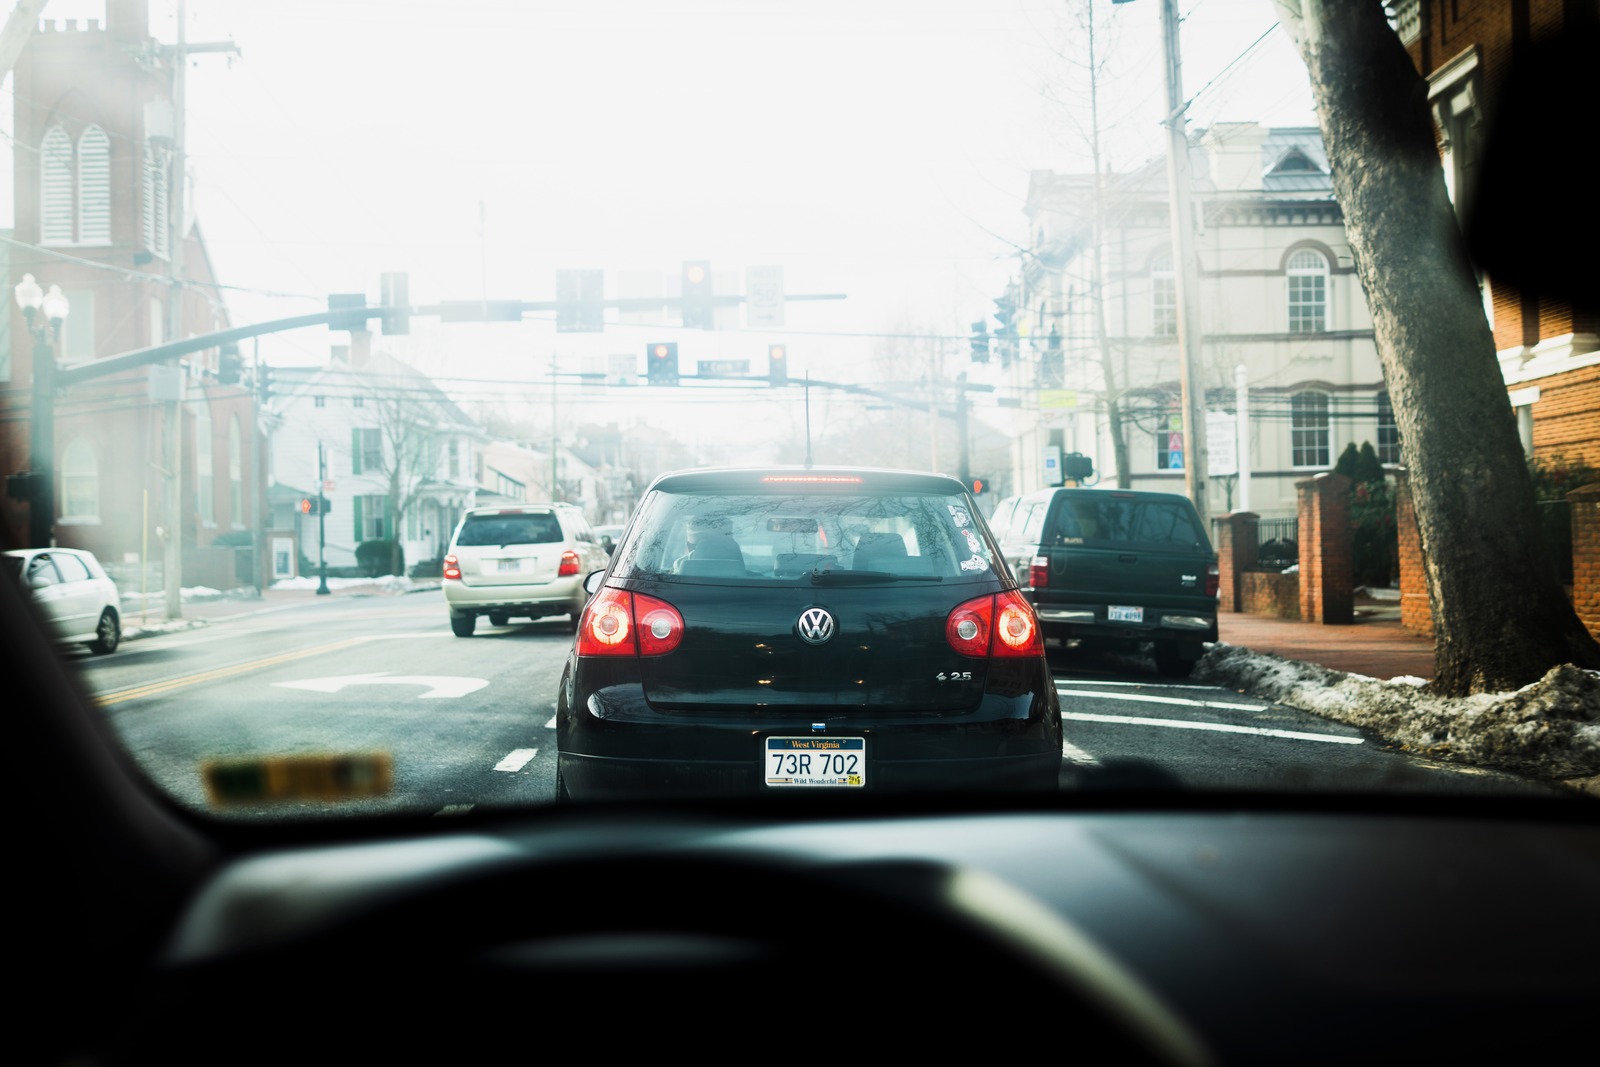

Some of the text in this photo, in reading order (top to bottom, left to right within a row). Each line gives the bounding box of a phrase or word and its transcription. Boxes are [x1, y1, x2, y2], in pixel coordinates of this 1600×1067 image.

[798, 608, 834, 642] VW
[791, 740, 840, 750] West Virginia
[772, 754, 858, 775] 73R 702
